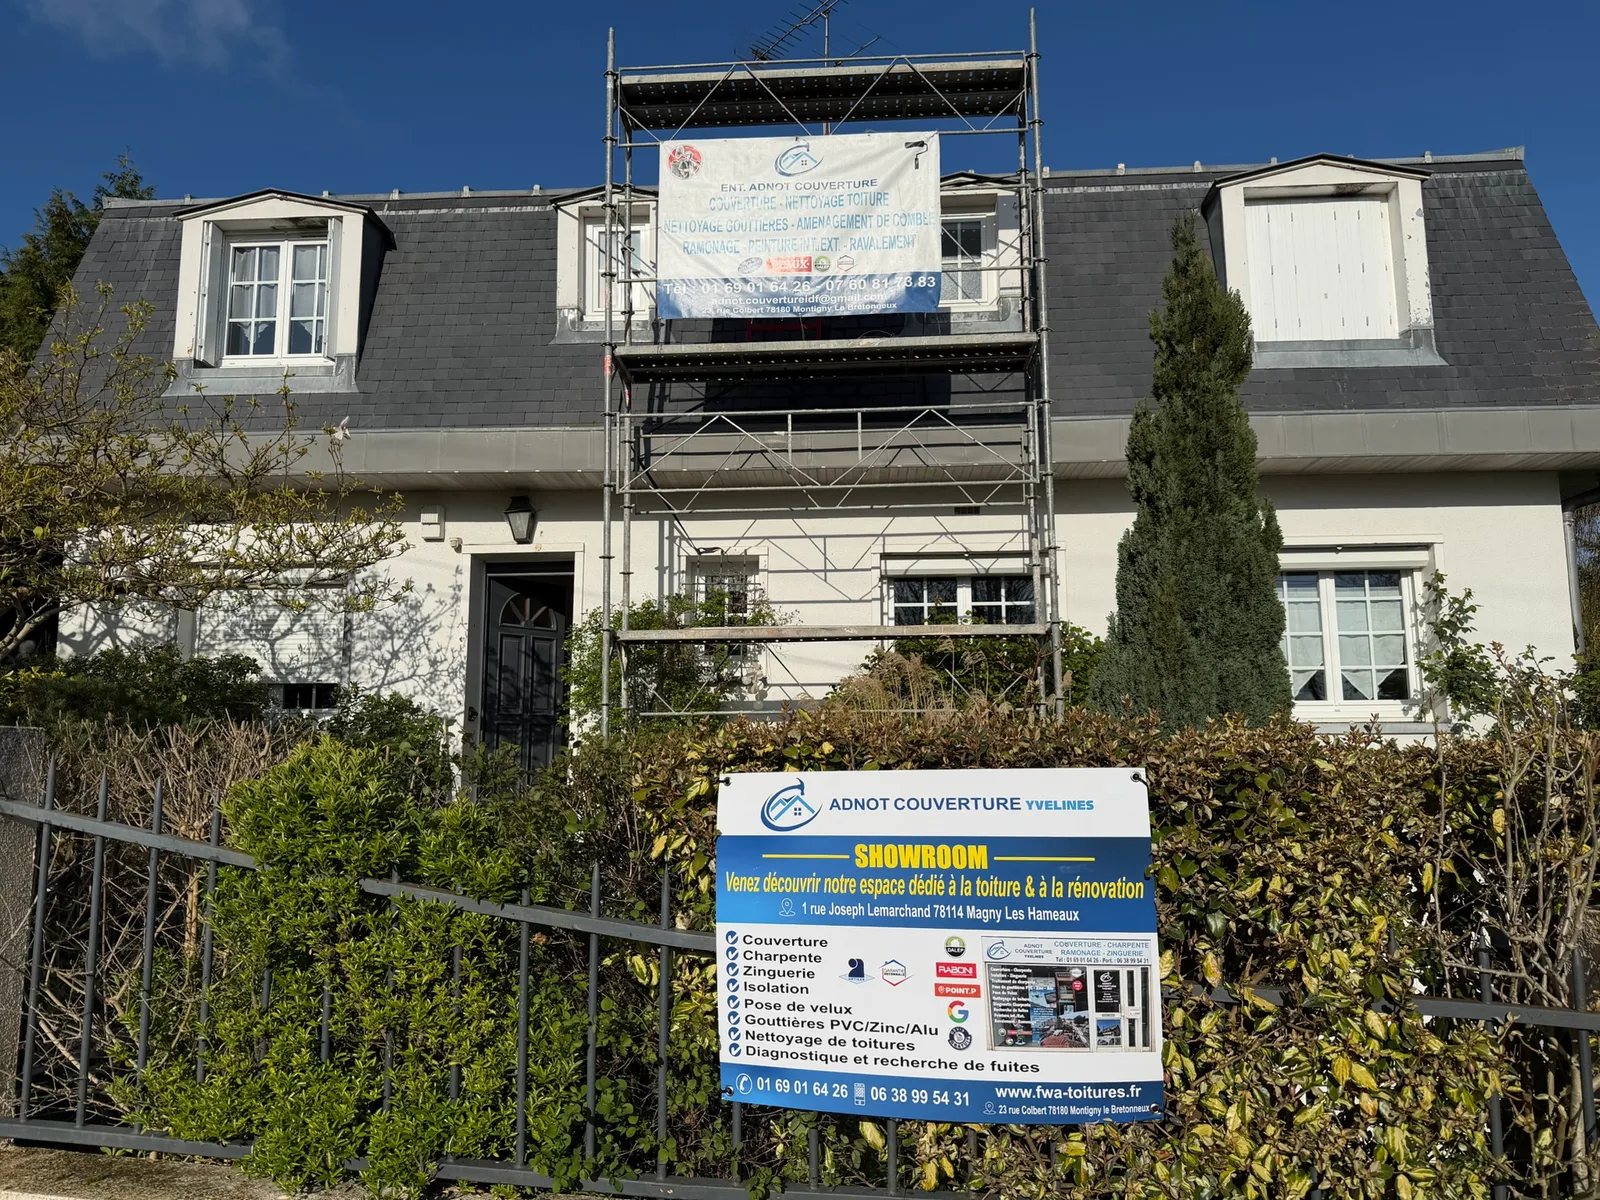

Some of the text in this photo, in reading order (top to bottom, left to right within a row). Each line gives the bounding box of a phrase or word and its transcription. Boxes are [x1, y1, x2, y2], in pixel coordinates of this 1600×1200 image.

[721, 179, 878, 192] ENT. ADNOT COUVERTURE
[709, 196, 777, 212] COUVERTURE
[785, 194, 845, 210] NETTOYAGE
[847, 192, 889, 207] TOITURE
[664, 219, 724, 233] NETTOYAGE
[726, 218, 789, 232] GOUTTIERES
[796, 215, 874, 230] AMENAGEMENT
[876, 213, 890, 228] DE
[683, 240, 741, 255] RAMONAGE
[748, 238, 798, 253] PEINTURE
[849, 234, 917, 251] RAVALEMENT
[701, 284, 718, 294] 01
[724, 283, 742, 294] 69
[747, 282, 763, 293] 01
[769, 281, 788, 292] 64
[792, 280, 811, 292] 26
[825, 280, 844, 291] 07
[849, 279, 867, 290] 60
[871, 278, 888, 289] 81
[895, 277, 913, 288] 73
[917, 276, 936, 288] 83
[711, 293, 888, 306] adnot.couvertureidf@gmail.com
[732, 305, 764, 314] Colbert
[792, 305, 832, 314] Montigny
[847, 302, 898, 310] Bretonneux
[829, 797, 1095, 811] ADNOT COUVERTURE YVELINES
[854, 843, 988, 870] SHOWROOM
[725, 871, 1144, 899] Venez découvrir notre espace dédié à la toiture & à la rénovation
[802, 901, 1080, 923] 1 rue Joseph Lemarchand 78114 Magny Les Hameaux
[743, 934, 828, 948] Couverture
[1107, 941, 1150, 949] CHARPENTE
[743, 950, 822, 964] Charpente
[743, 965, 816, 980] Zinguerie
[938, 966, 973, 975] RABONI
[744, 981, 809, 995] Isolation
[945, 987, 977, 995] POINT.P
[744, 999, 853, 1015] Pose de velux
[744, 1014, 939, 1036] Gouttières PVC/Zinc/Alu
[745, 1029, 916, 1051] Nettoyage de toitures
[745, 1045, 1041, 1073] Diagnostique et recherche de fuites
[756, 1076, 848, 1098] 01 69 01 64 26
[995, 1084, 1142, 1099] www.fwa-toitures.fr
[870, 1086, 970, 1107] 06 38 99 54 31
[998, 1104, 1150, 1117] 23 rue Colbert 78180 Montigny le Bretonneux
